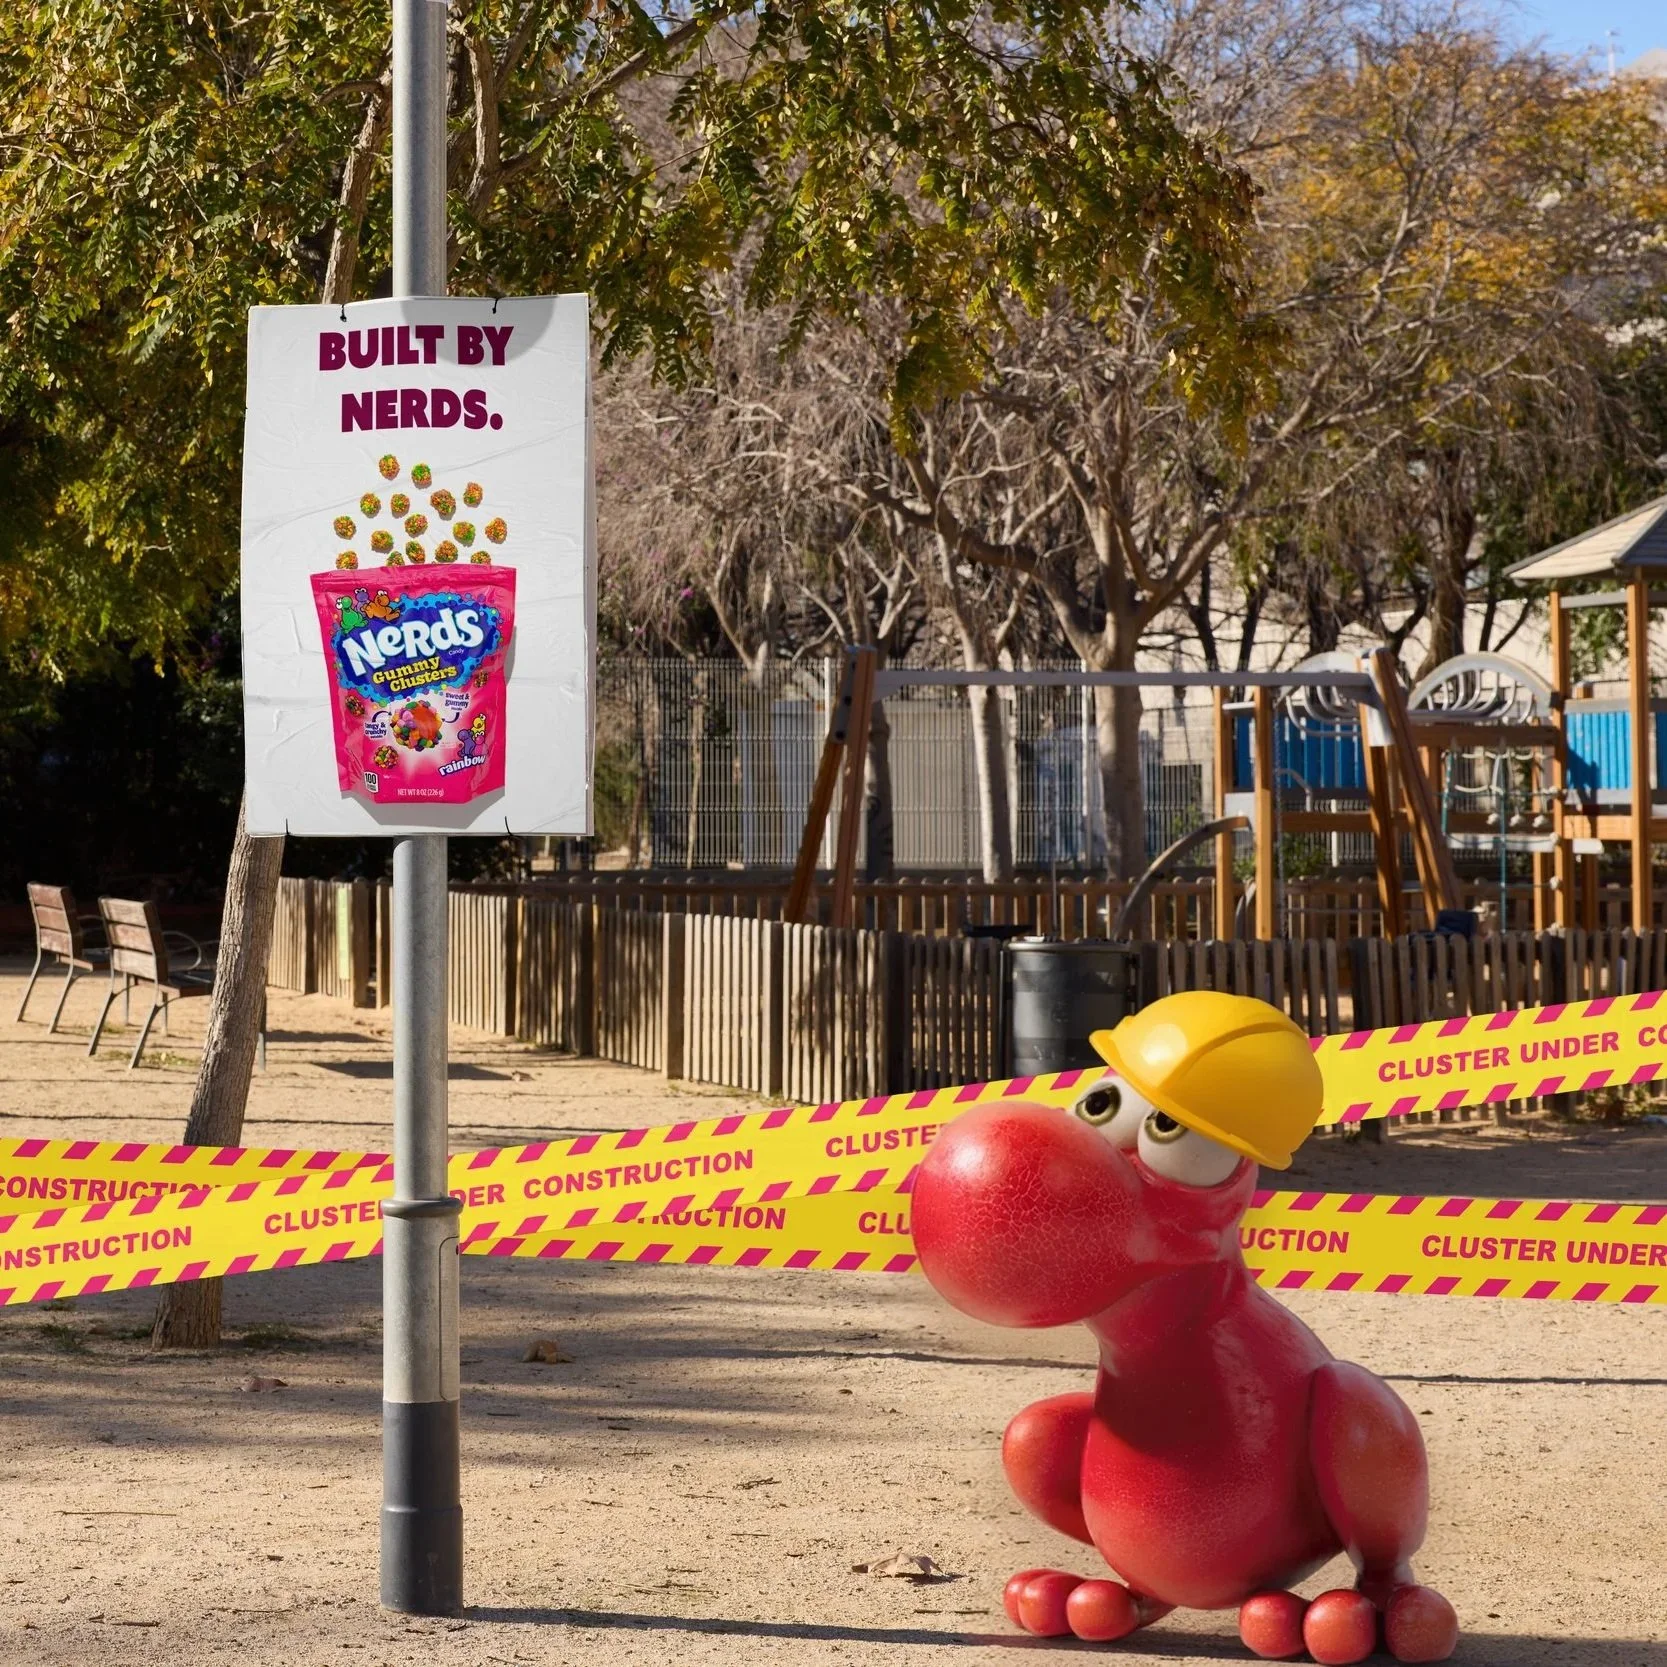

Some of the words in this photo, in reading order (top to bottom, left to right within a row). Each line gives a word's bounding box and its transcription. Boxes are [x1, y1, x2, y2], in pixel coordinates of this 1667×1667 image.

[320, 325, 444, 371] BUILT
[457, 325, 514, 366] BY
[341, 388, 504, 432] NERDS.
[372, 656, 440, 684] Gummy
[389, 665, 457, 692] Clusters
[364, 772, 377, 785] 100
[439, 755, 486, 776] rainbow
[1377, 1047, 1510, 1083] CLUSTER
[1520, 1031, 1620, 1063] UNDER
[825, 1123, 946, 1158] CLUSTE
[449, 1184, 506, 1208] DER
[523, 1149, 753, 1199] CONSTRUCTION
[0, 1225, 192, 1271] NSTRUCTION
[1237, 1228, 1349, 1254] UCTION
[1421, 1234, 1556, 1262] CLUSTER
[1566, 1240, 1667, 1267] UNDER
